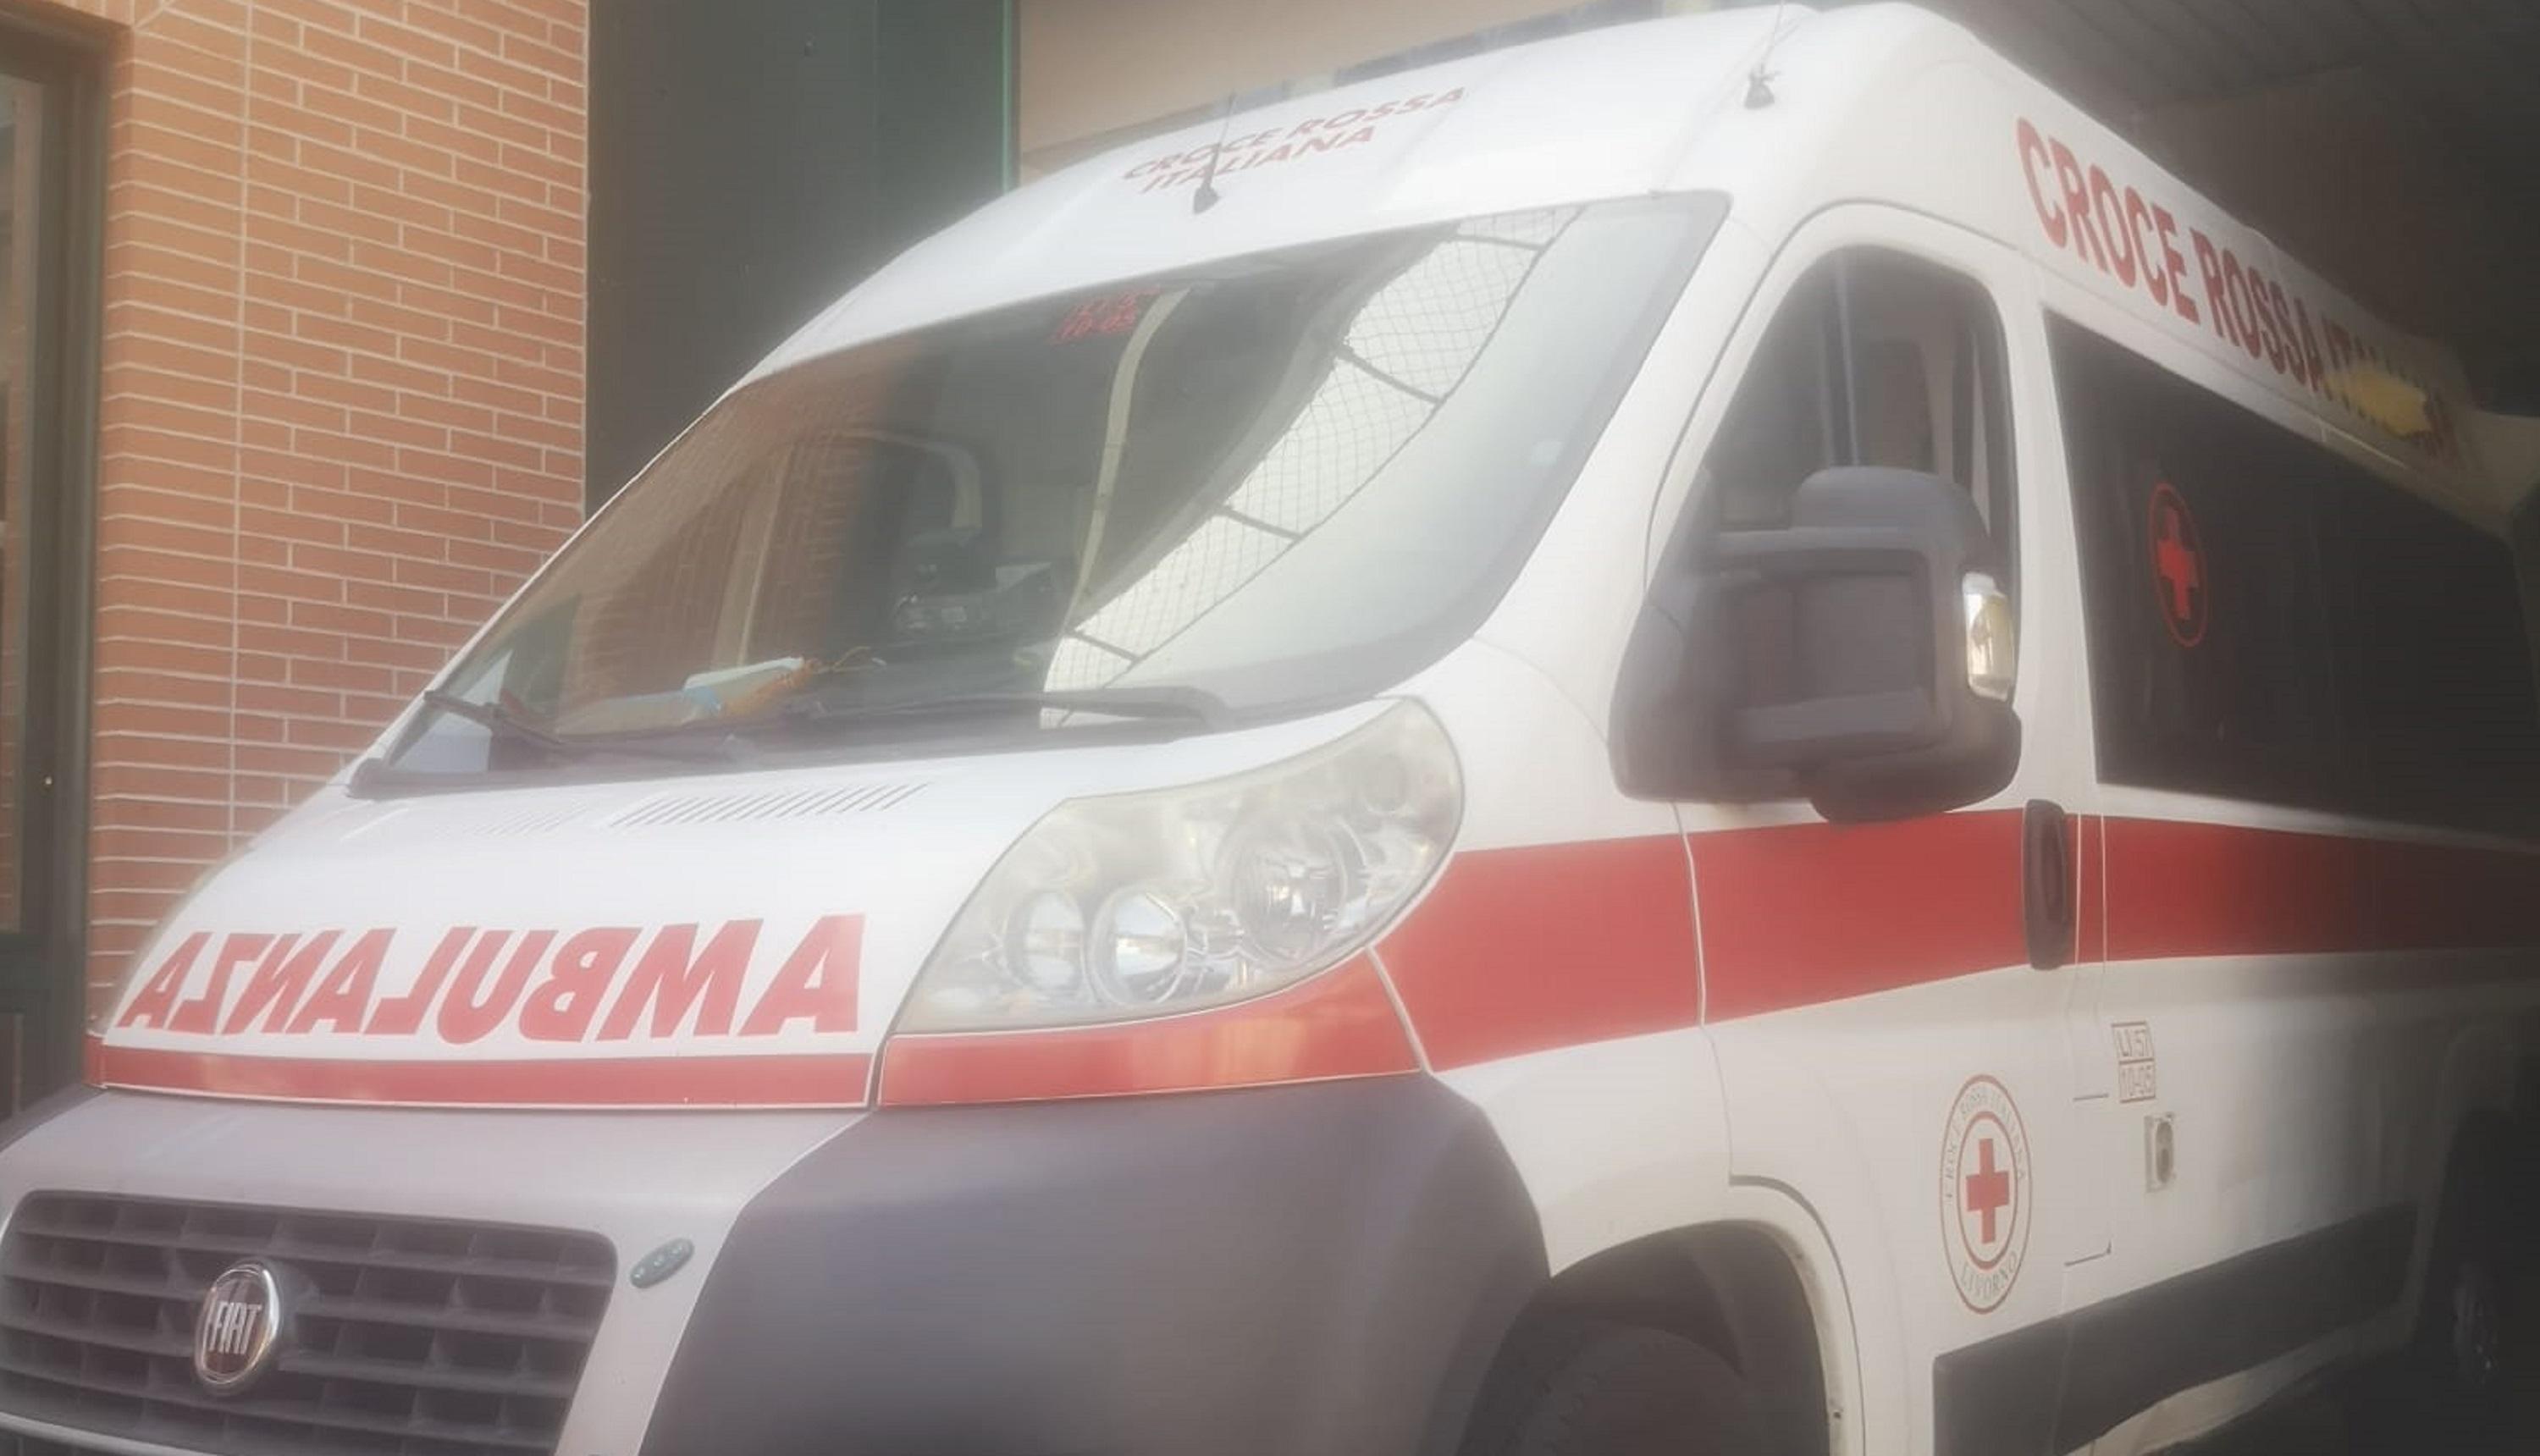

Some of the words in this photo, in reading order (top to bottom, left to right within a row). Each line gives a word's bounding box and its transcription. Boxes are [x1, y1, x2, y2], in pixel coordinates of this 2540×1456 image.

[1123, 128, 1284, 180] CROCE
[1293, 86, 1466, 139] ROSSA
[1141, 126, 1377, 193] ITALIANA
[2016, 117, 2200, 325] CROCE
[2190, 227, 2325, 393] ROSSA
[208, 1301, 262, 1354] FIAT
